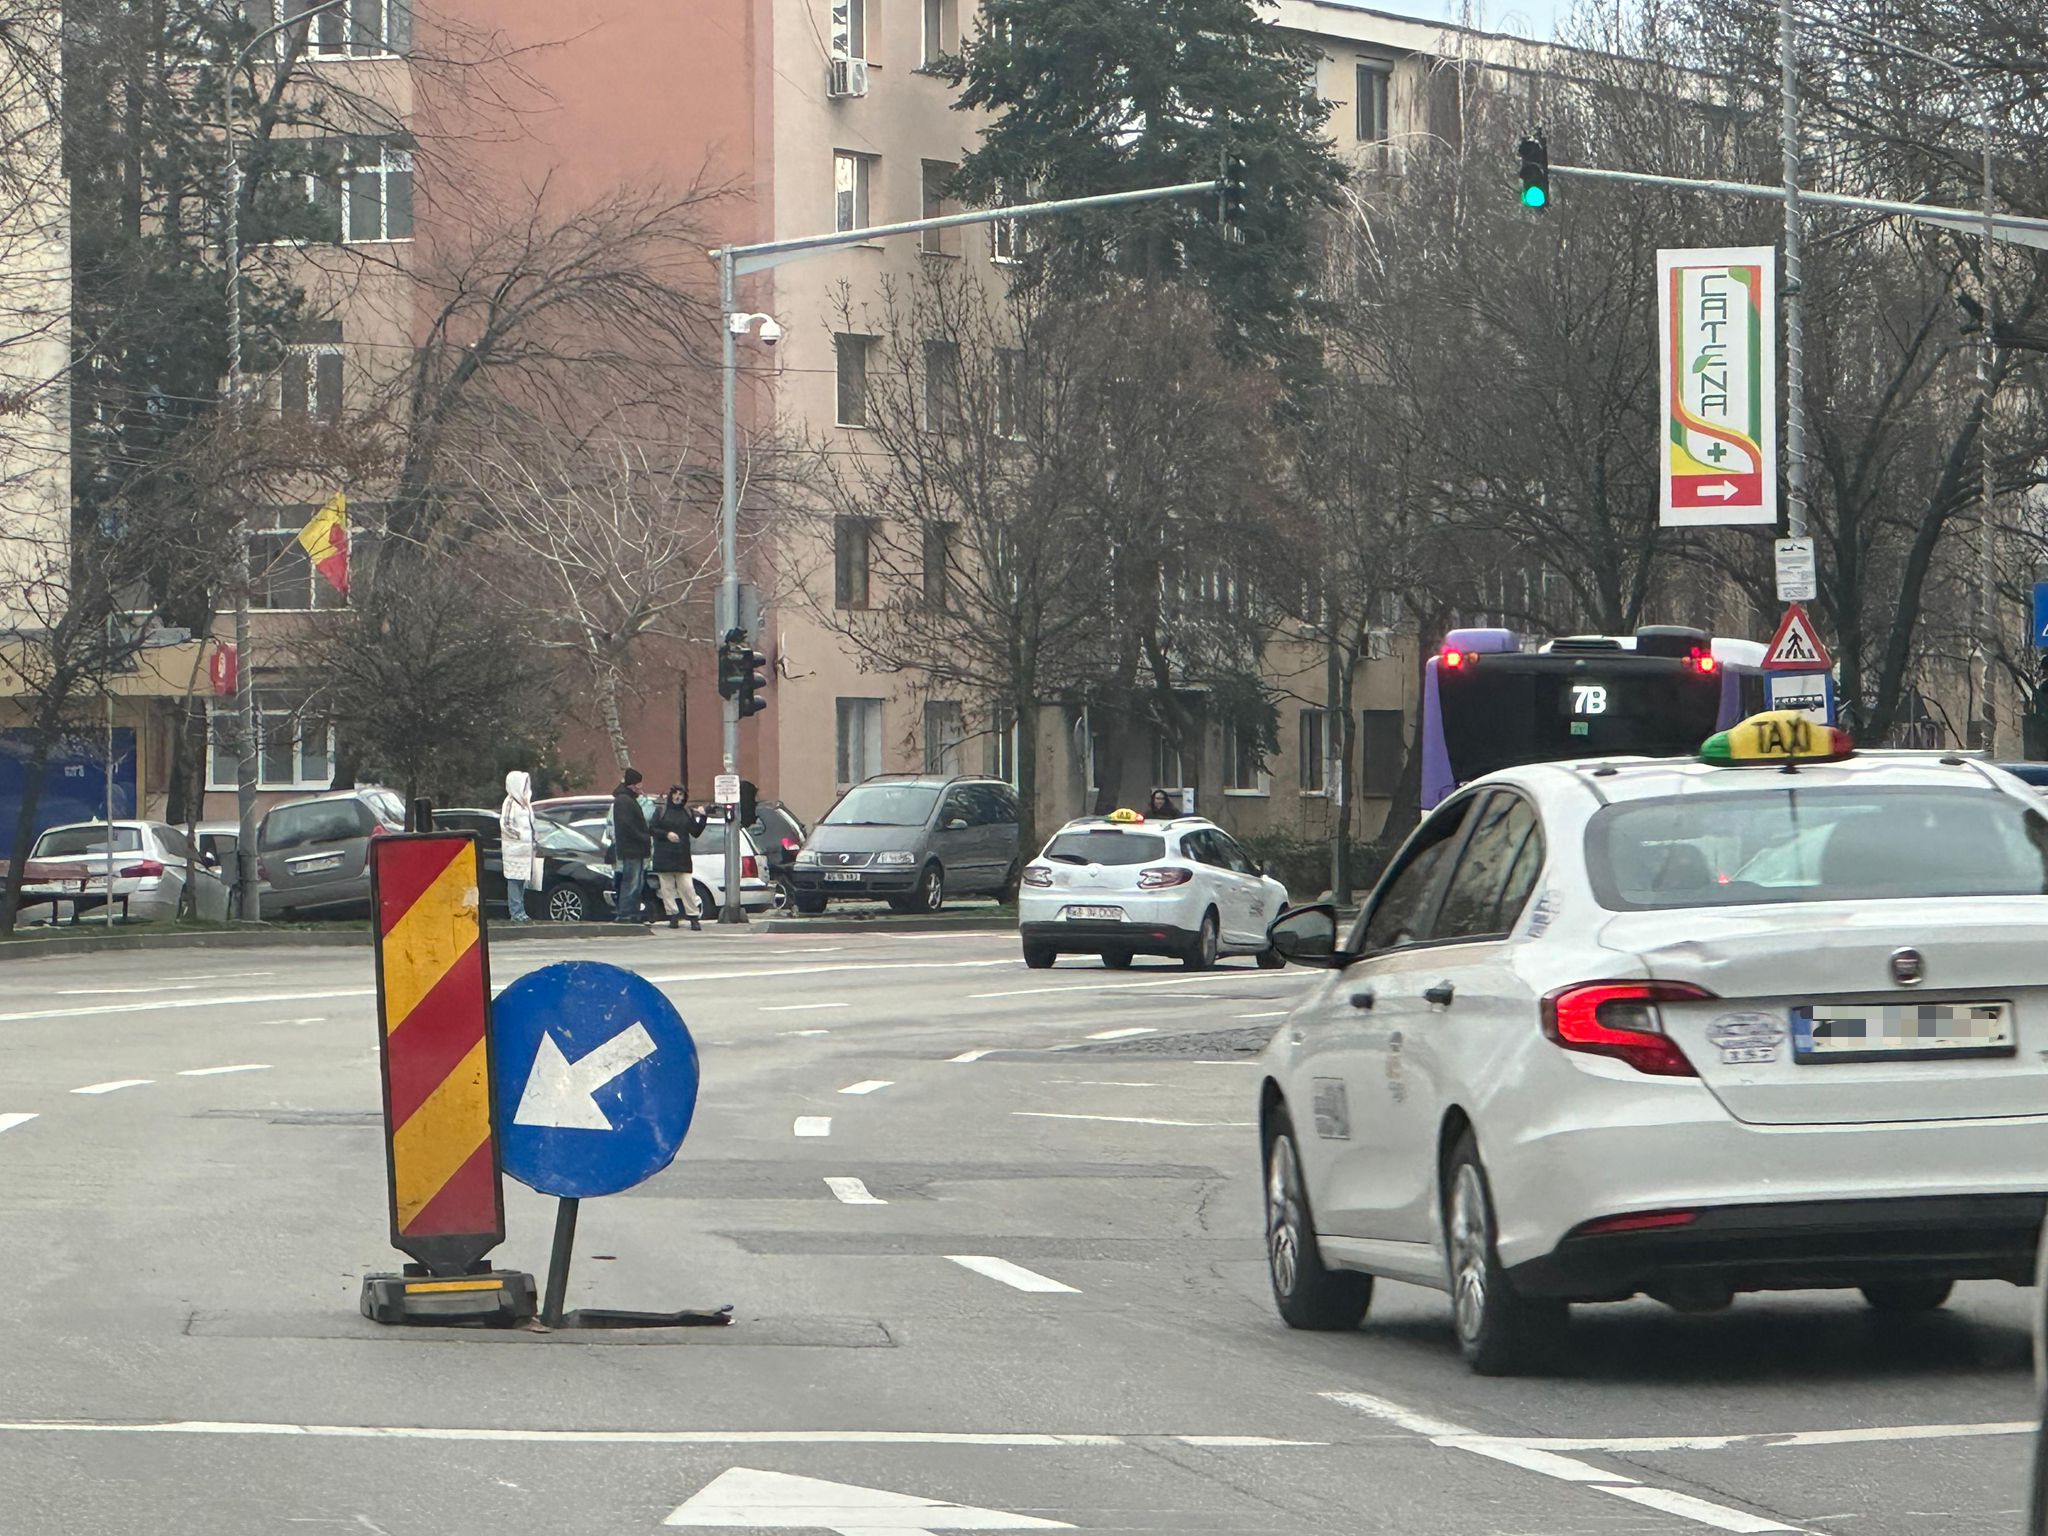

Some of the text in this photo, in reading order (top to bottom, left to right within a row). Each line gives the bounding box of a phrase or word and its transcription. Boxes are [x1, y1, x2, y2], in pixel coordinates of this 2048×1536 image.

[1699, 274, 1728, 417] CATENA
[1572, 685, 1607, 714] 7B
[1752, 717, 1812, 754] TAXI
